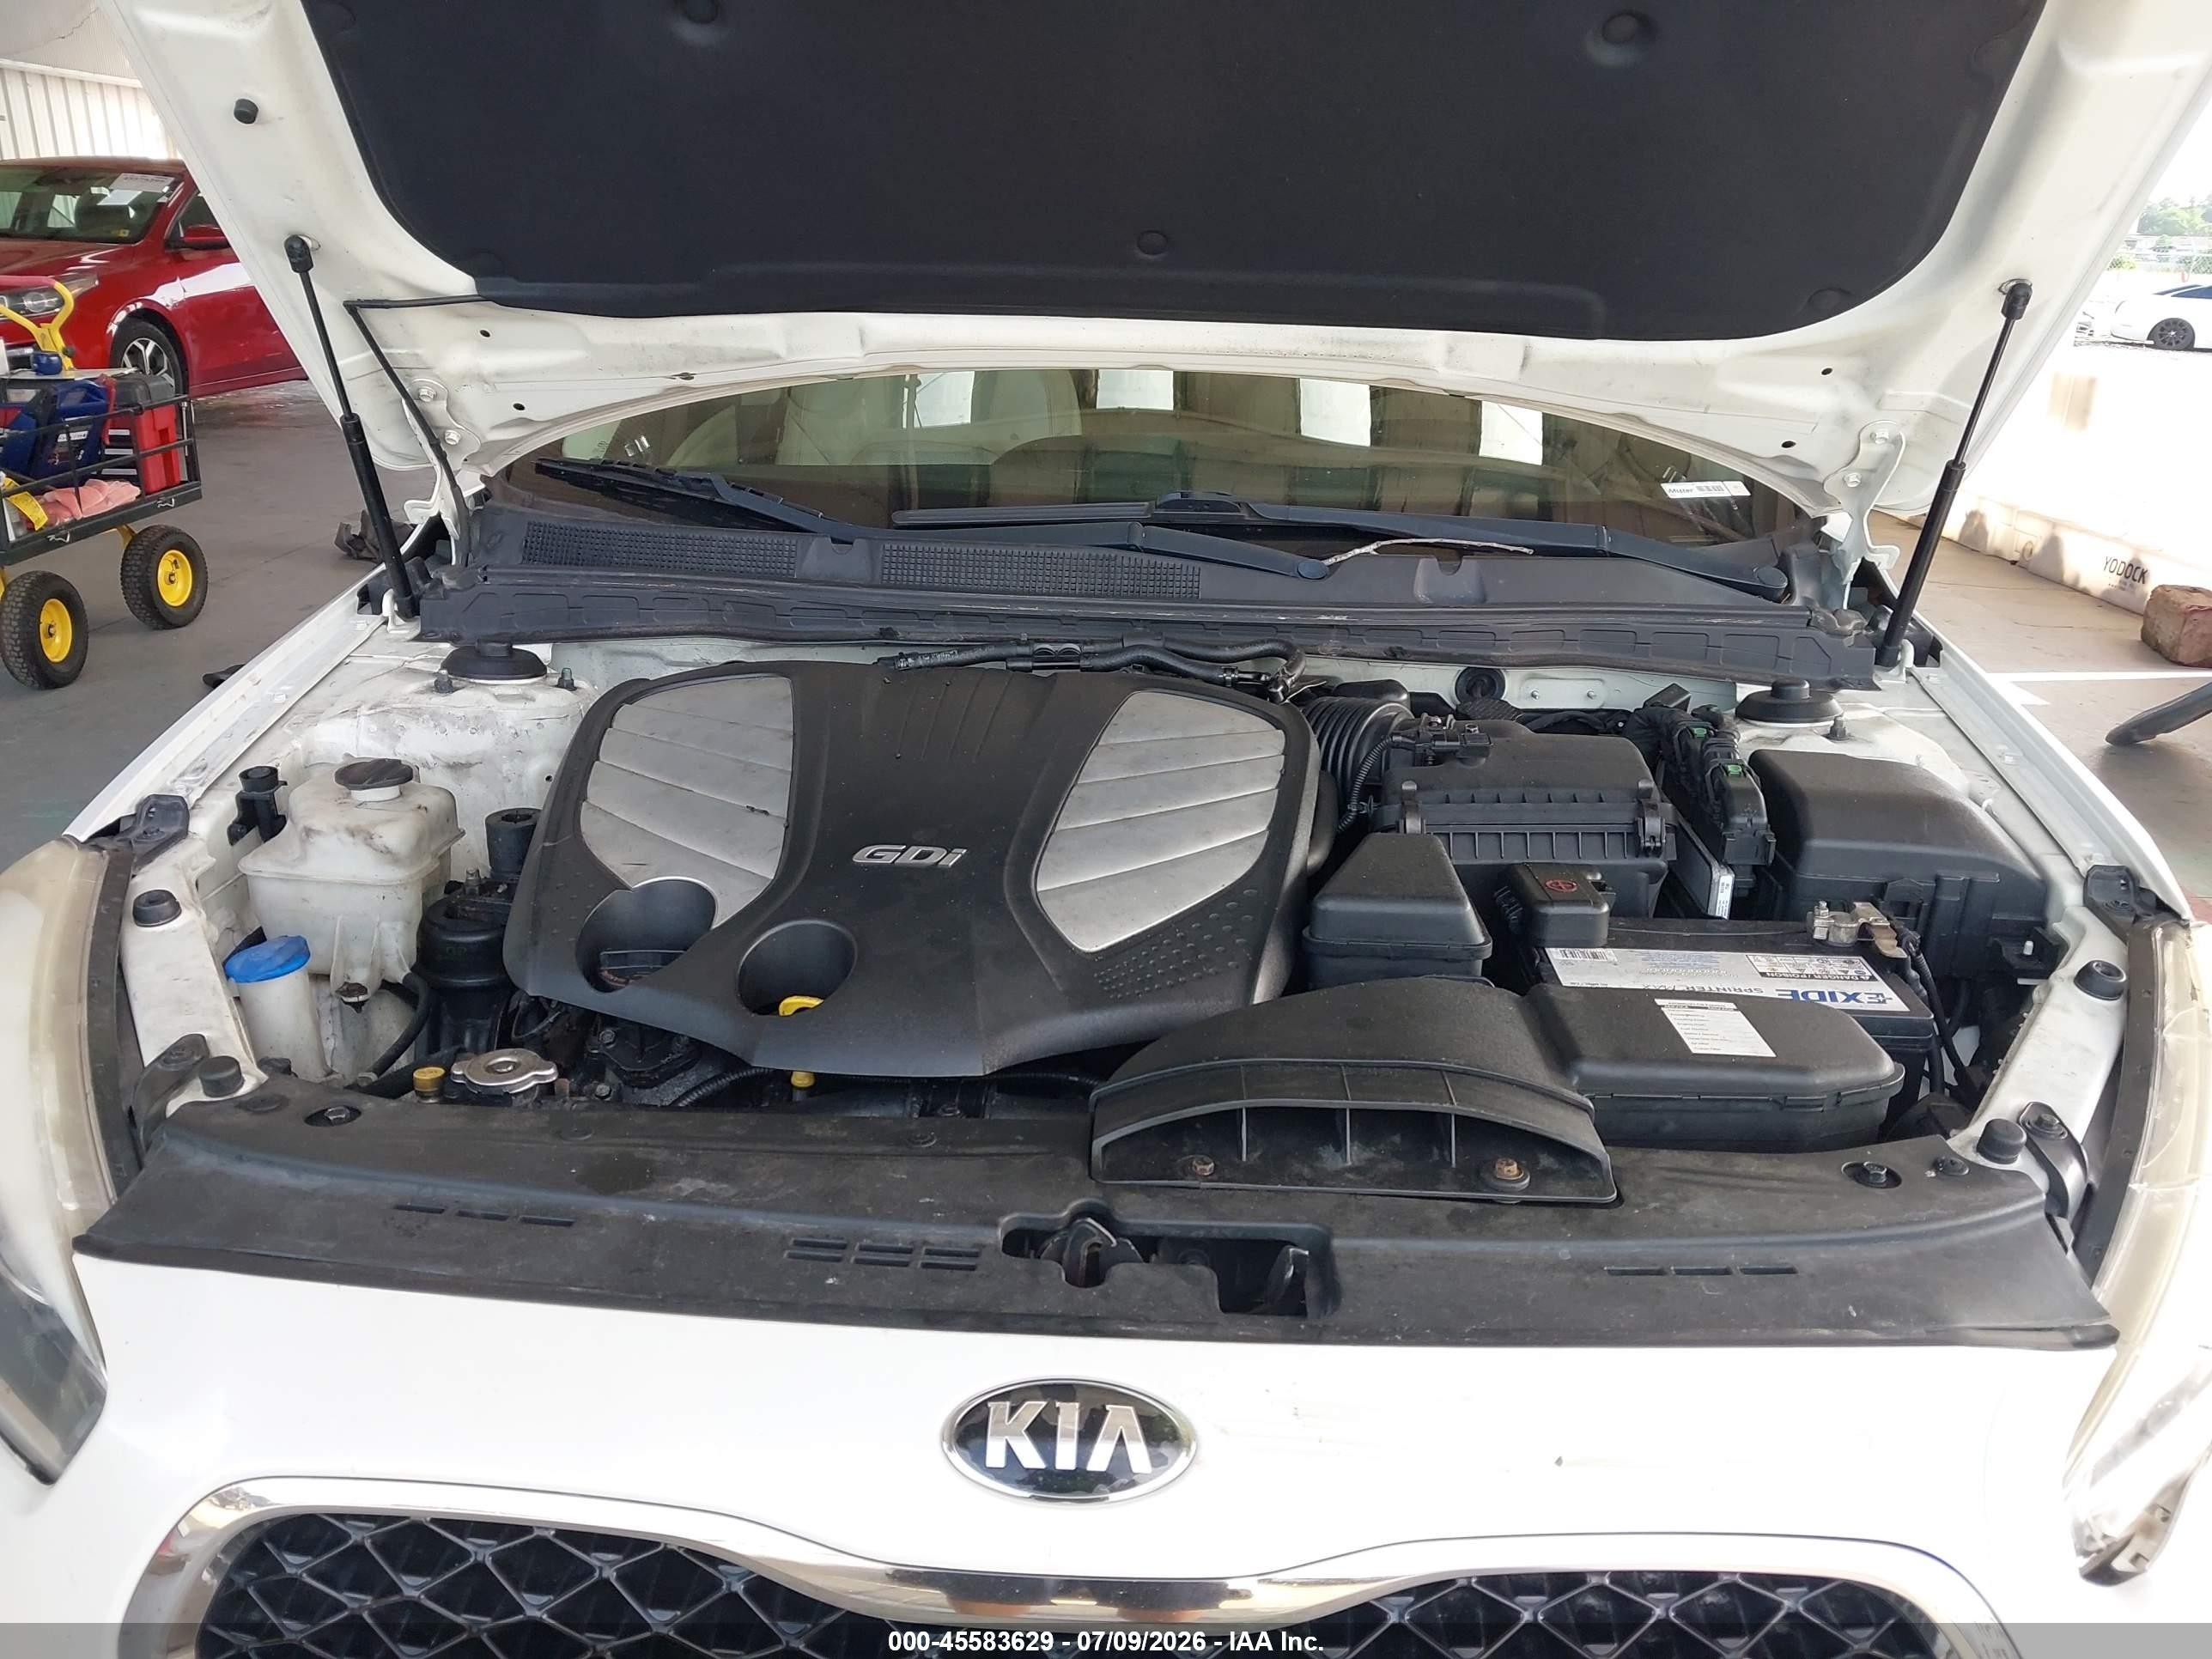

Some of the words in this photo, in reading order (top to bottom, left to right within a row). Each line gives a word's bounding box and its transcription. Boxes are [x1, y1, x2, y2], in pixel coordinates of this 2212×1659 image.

[2104, 556, 2148, 584] YODOCK
[852, 844, 968, 867] GDi
[1777, 989, 1892, 1003] EXIDE
[985, 1401, 1152, 1474] KIA
